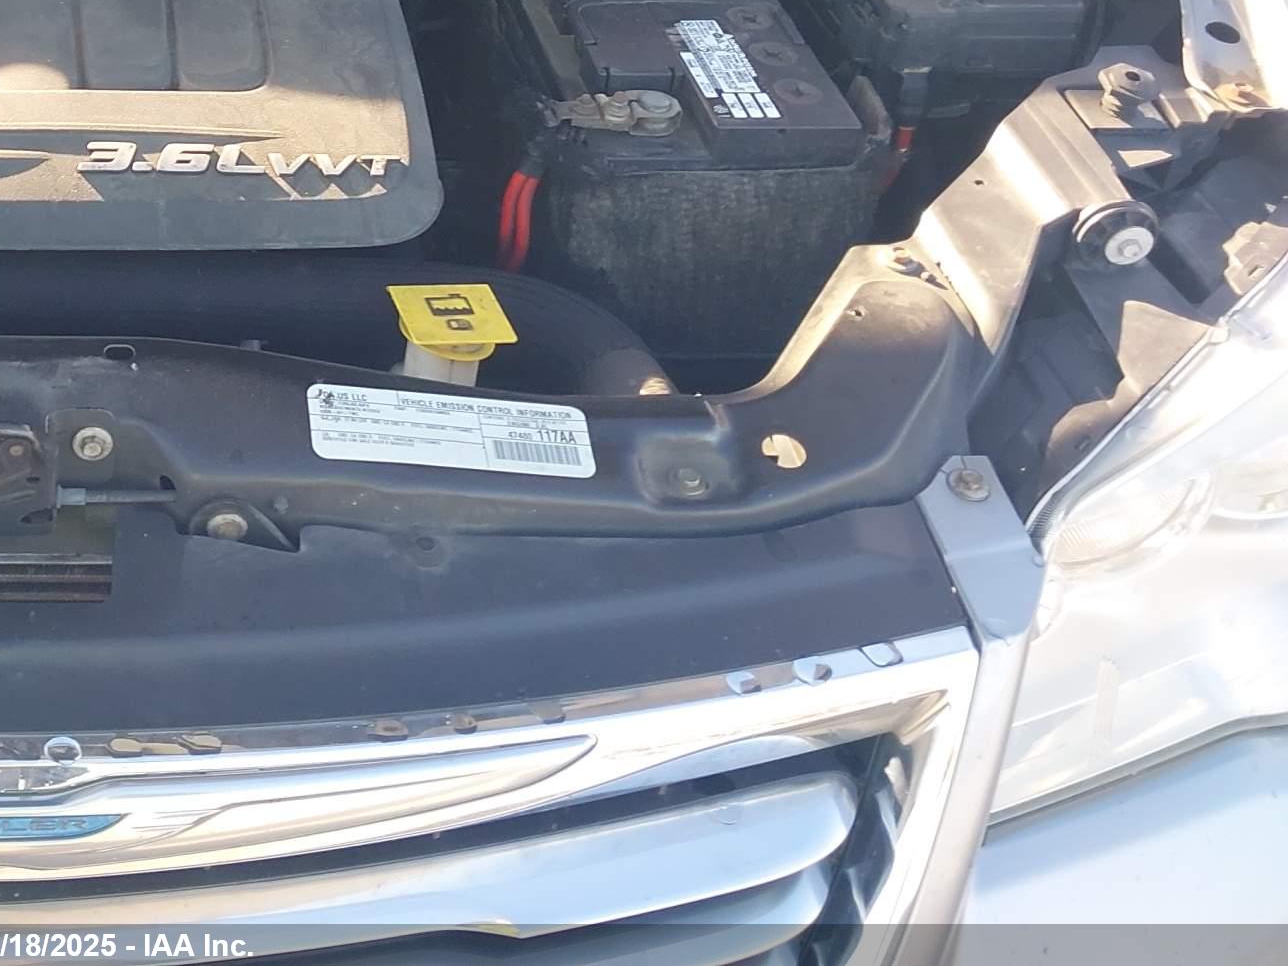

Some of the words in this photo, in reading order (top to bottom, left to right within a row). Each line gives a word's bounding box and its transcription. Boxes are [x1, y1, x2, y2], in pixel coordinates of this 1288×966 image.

[401, 398, 433, 408] VEHICLE
[436, 401, 475, 412] EMISSION
[477, 405, 513, 415] CONTROL
[516, 409, 572, 419] INFORMATION
[537, 430, 577, 444] 117AA
